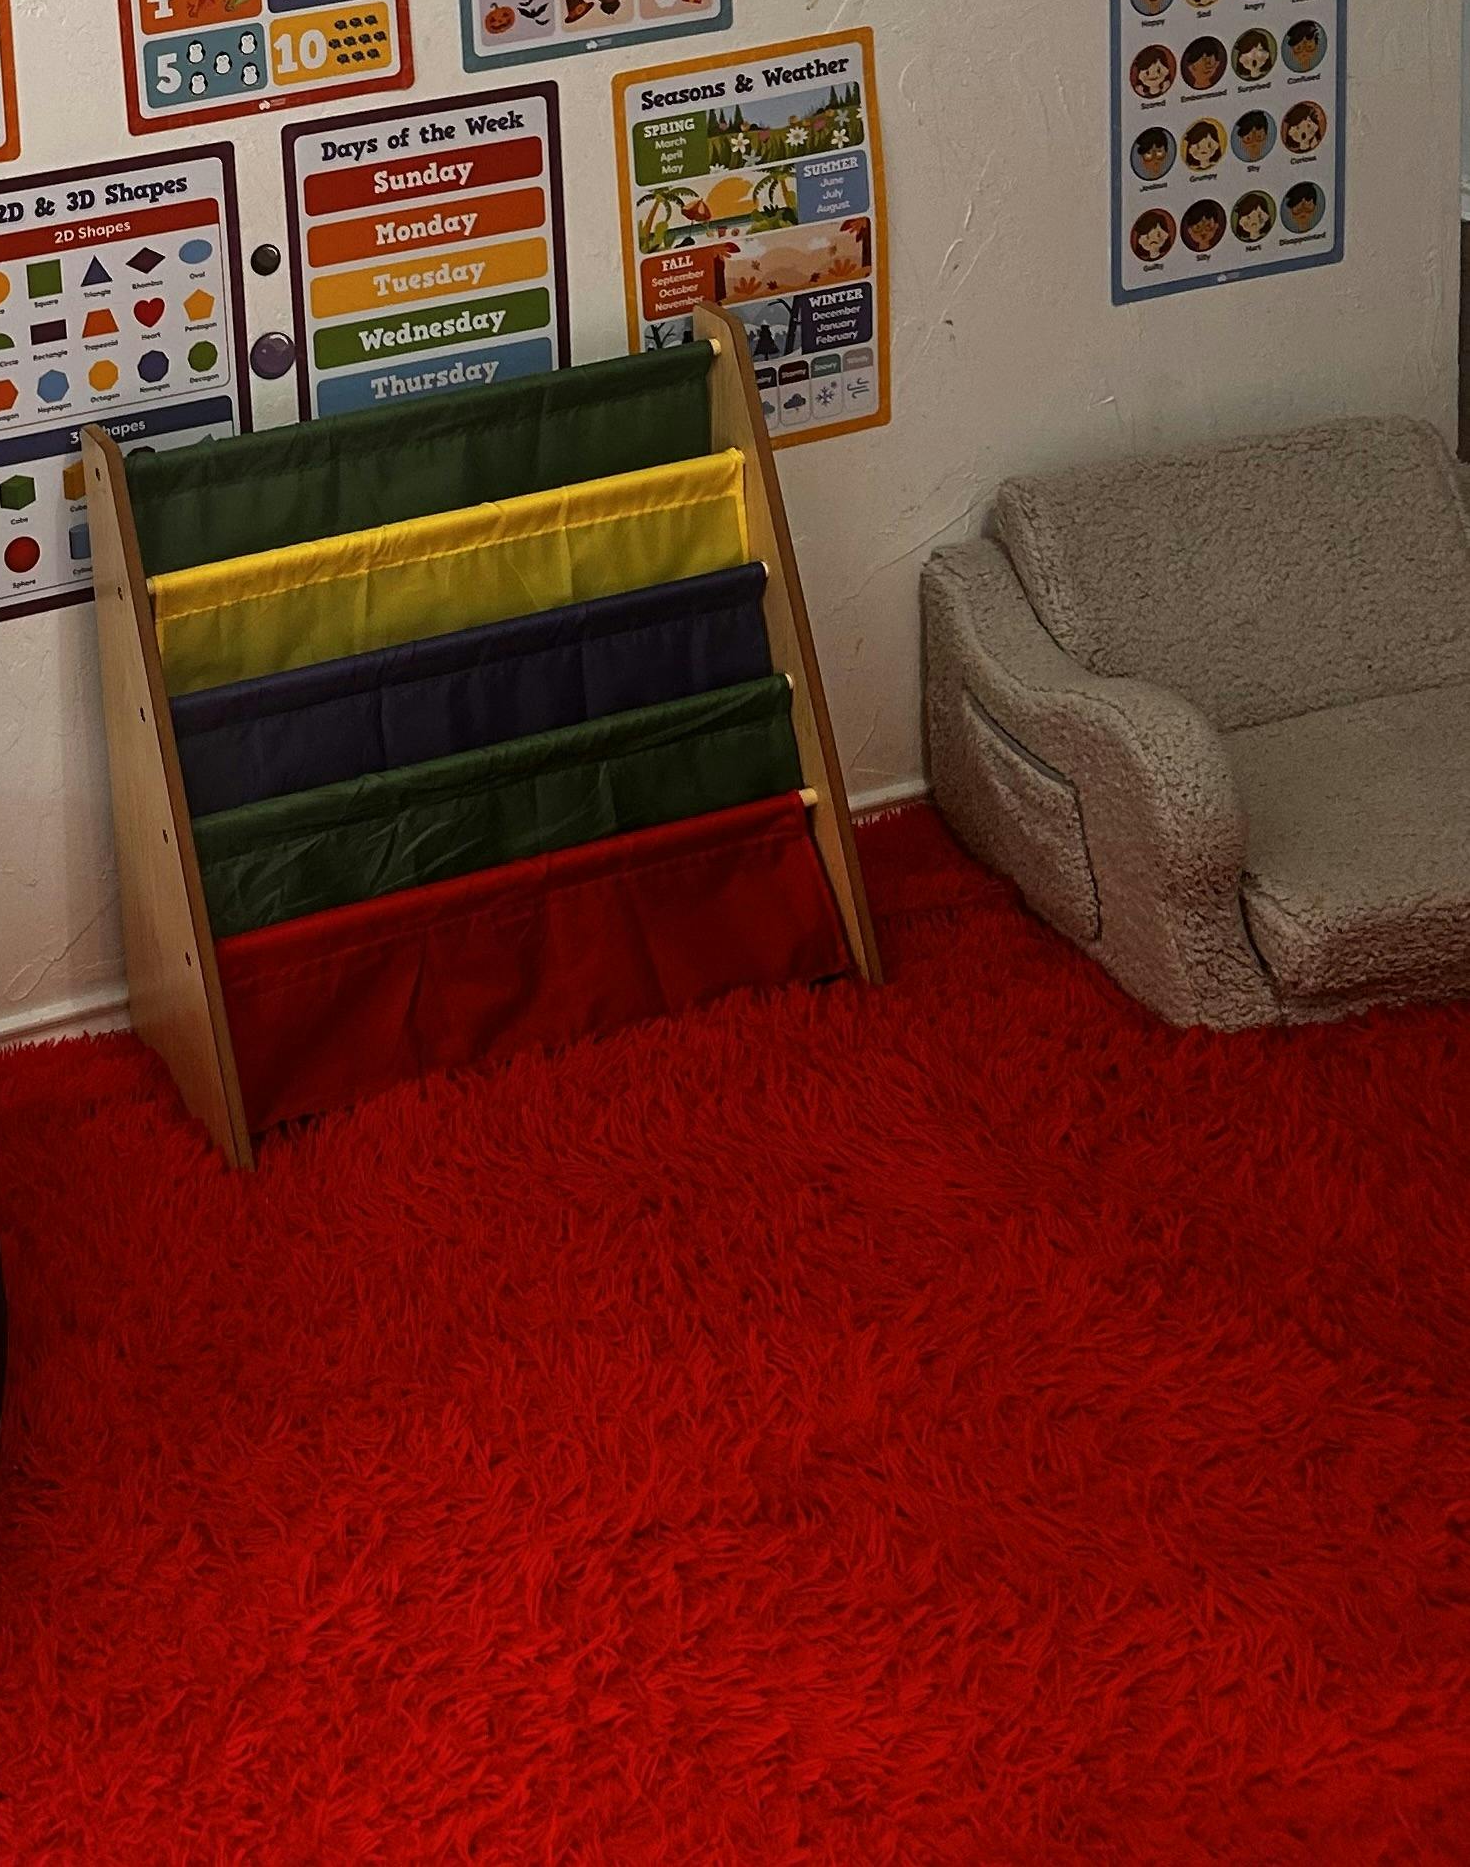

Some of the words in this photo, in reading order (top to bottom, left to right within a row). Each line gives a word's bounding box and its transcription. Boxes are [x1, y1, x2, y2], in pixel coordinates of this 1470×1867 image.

[1142, 18, 1165, 27] Happy
[1197, 10, 1211, 18] Sad
[1244, 2, 1265, 11] Angry
[641, 80, 726, 110] Seasons
[735, 74, 753, 94] &
[762, 56, 850, 88] Weather
[321, 137, 378, 162] Days
[387, 128, 410, 148] of
[419, 124, 456, 143] the
[465, 111, 524, 136] Week
[643, 119, 695, 139] SPRING
[654, 135, 687, 150] March
[373, 162, 474, 194] Sunday
[803, 156, 859, 179] SUMMER
[34, 197, 55, 216] &
[66, 189, 95, 212] 3D
[105, 175, 188, 205] Shapes
[54, 229, 74, 244] 2D
[78, 219, 131, 240] Shapes
[375, 212, 478, 246] Monday
[661, 255, 694, 273] FALL
[372, 262, 486, 296] Tuesday
[651, 269, 705, 288] September
[808, 288, 863, 309] WINTER
[358, 310, 507, 351] Wednesday
[370, 361, 500, 400] Thursday
